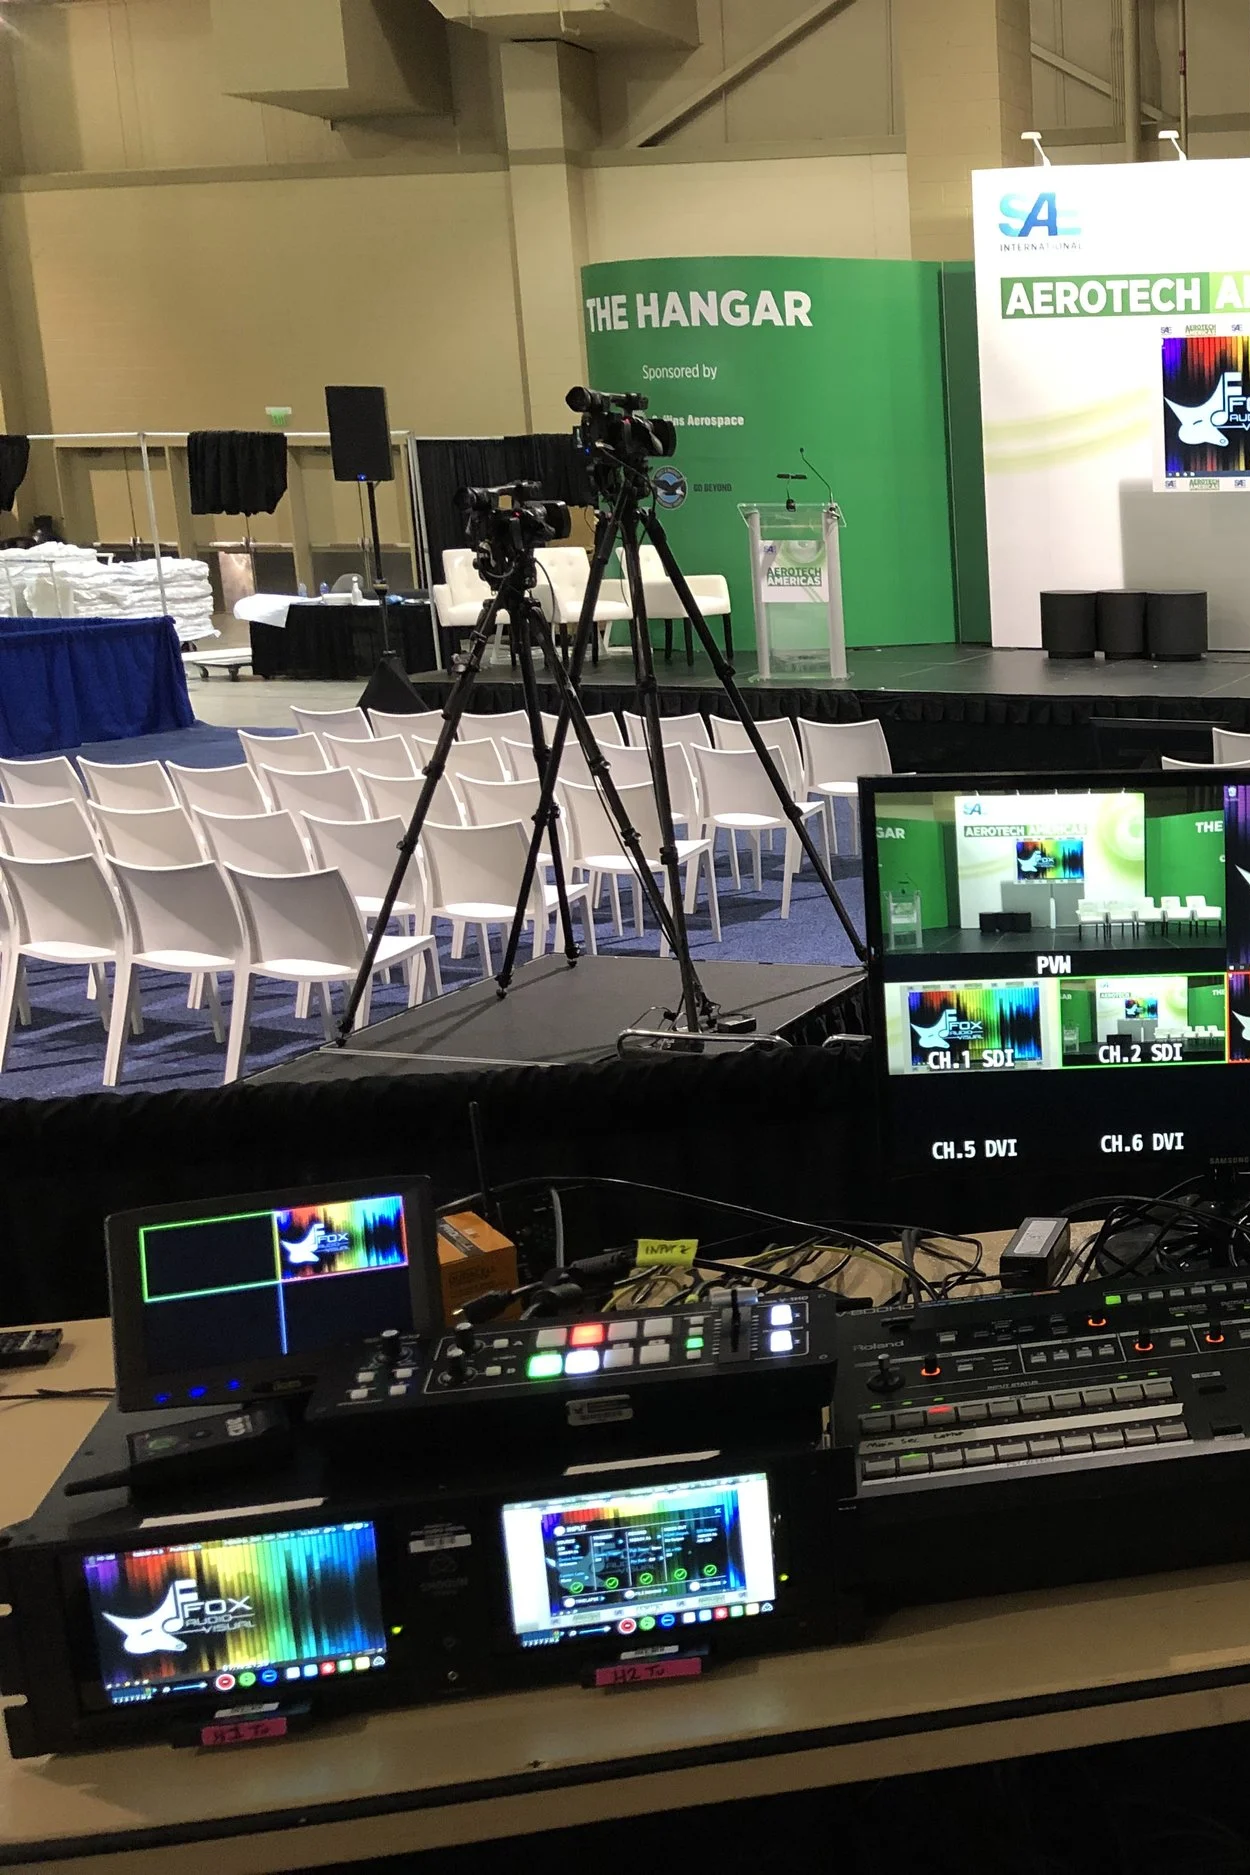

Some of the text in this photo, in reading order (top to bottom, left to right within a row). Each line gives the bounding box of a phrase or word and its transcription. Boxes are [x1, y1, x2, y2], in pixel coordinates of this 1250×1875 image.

[1005, 278, 1201, 316] AEROTECH
[586, 289, 814, 333] THE HANGAR
[642, 363, 718, 380] Sponsored by
[687, 414, 744, 429] Aerospace
[767, 567, 822, 577] AEROTECH
[767, 576, 821, 586] AMERICAS
[965, 825, 1025, 837] AEROTECH
[1195, 821, 1224, 833] THE
[949, 1021, 983, 1031] FOX
[927, 1049, 1015, 1070] CH.1 SDI
[1098, 1043, 1183, 1064] CH.2 SDI
[931, 1139, 1018, 1160] CH.5 DVI
[1100, 1132, 1184, 1153] CH.6 DVI
[317, 1232, 349, 1249] FOX
[853, 1339, 905, 1351] Roland
[182, 1595, 254, 1618] FOX
[184, 1615, 233, 1627] AUDIO
[201, 1619, 257, 1634] VISUAL
